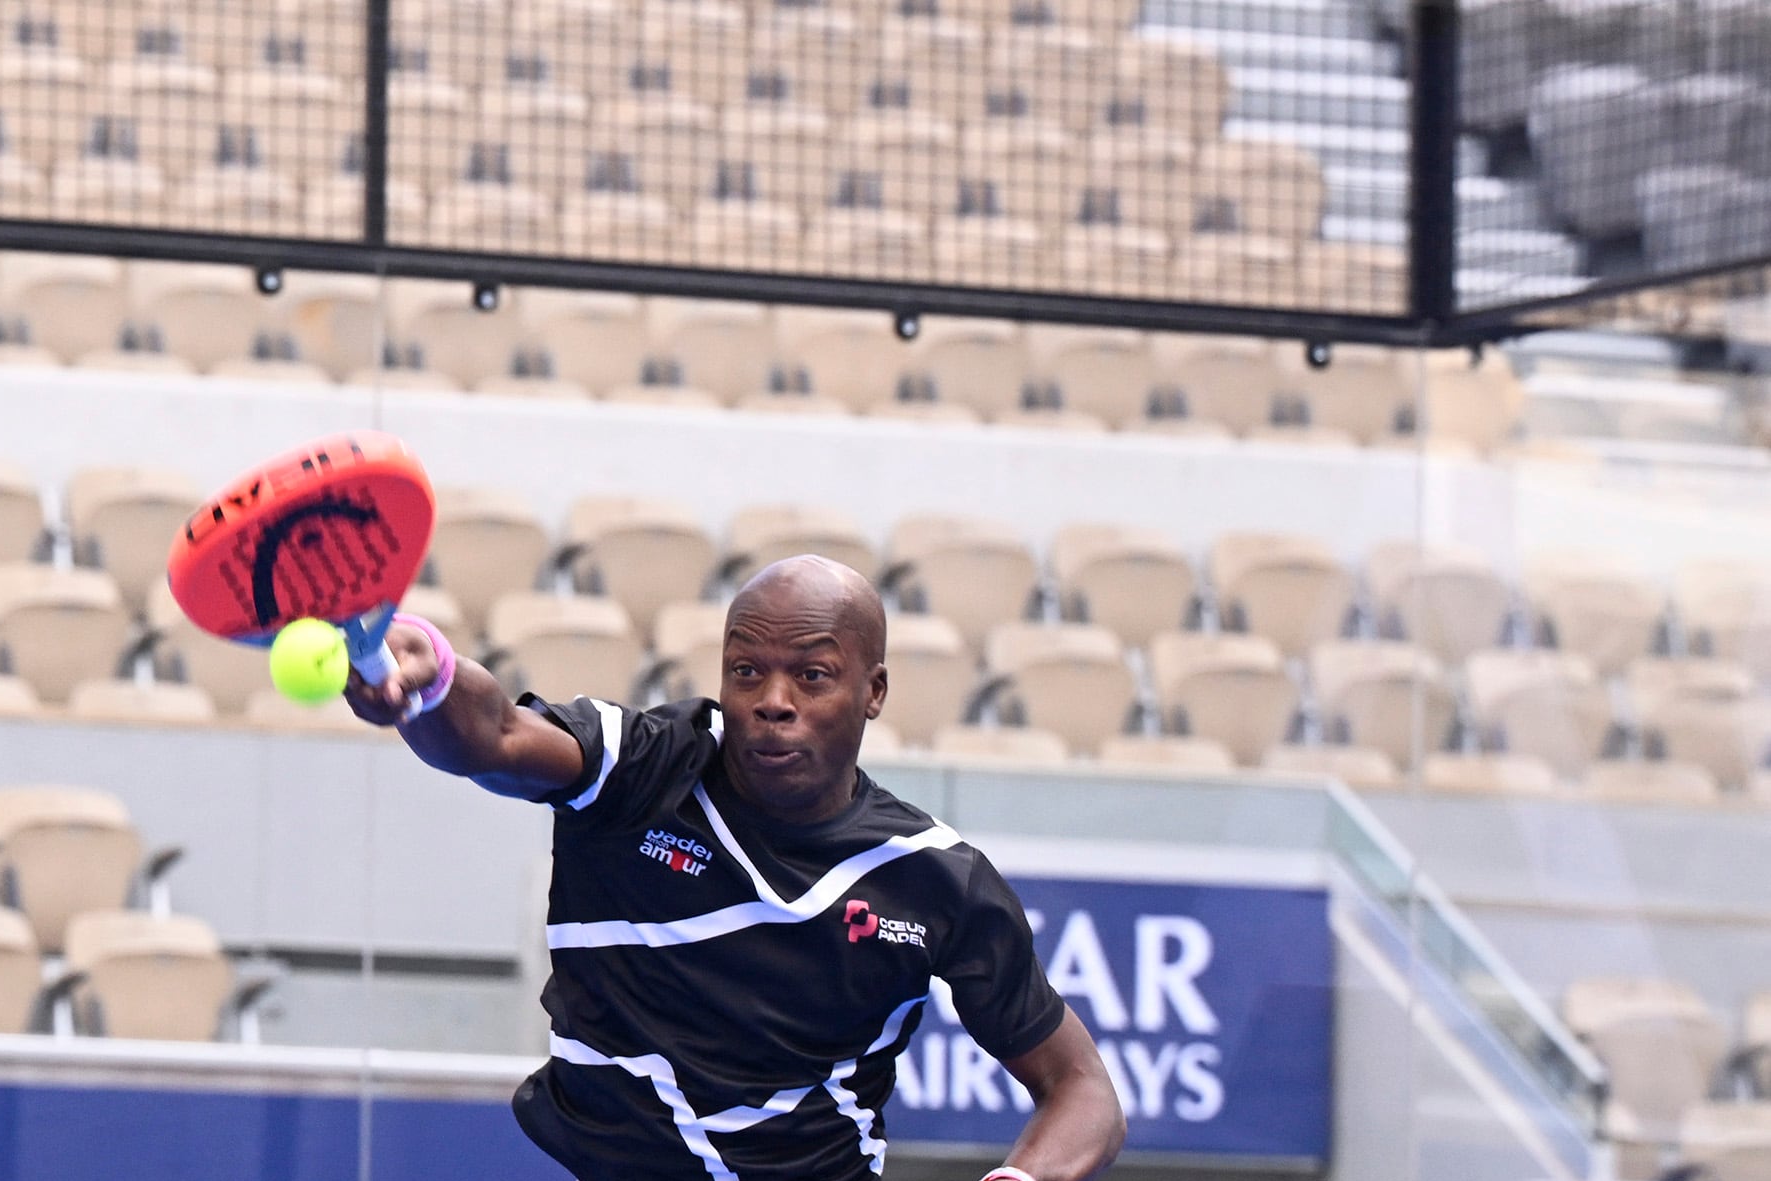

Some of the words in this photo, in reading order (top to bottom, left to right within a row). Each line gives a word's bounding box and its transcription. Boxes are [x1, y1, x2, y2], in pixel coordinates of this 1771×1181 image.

[879, 917, 927, 937] CŒUR
[878, 929, 926, 949] PADEL
[894, 1029, 1225, 1123] IRYS
